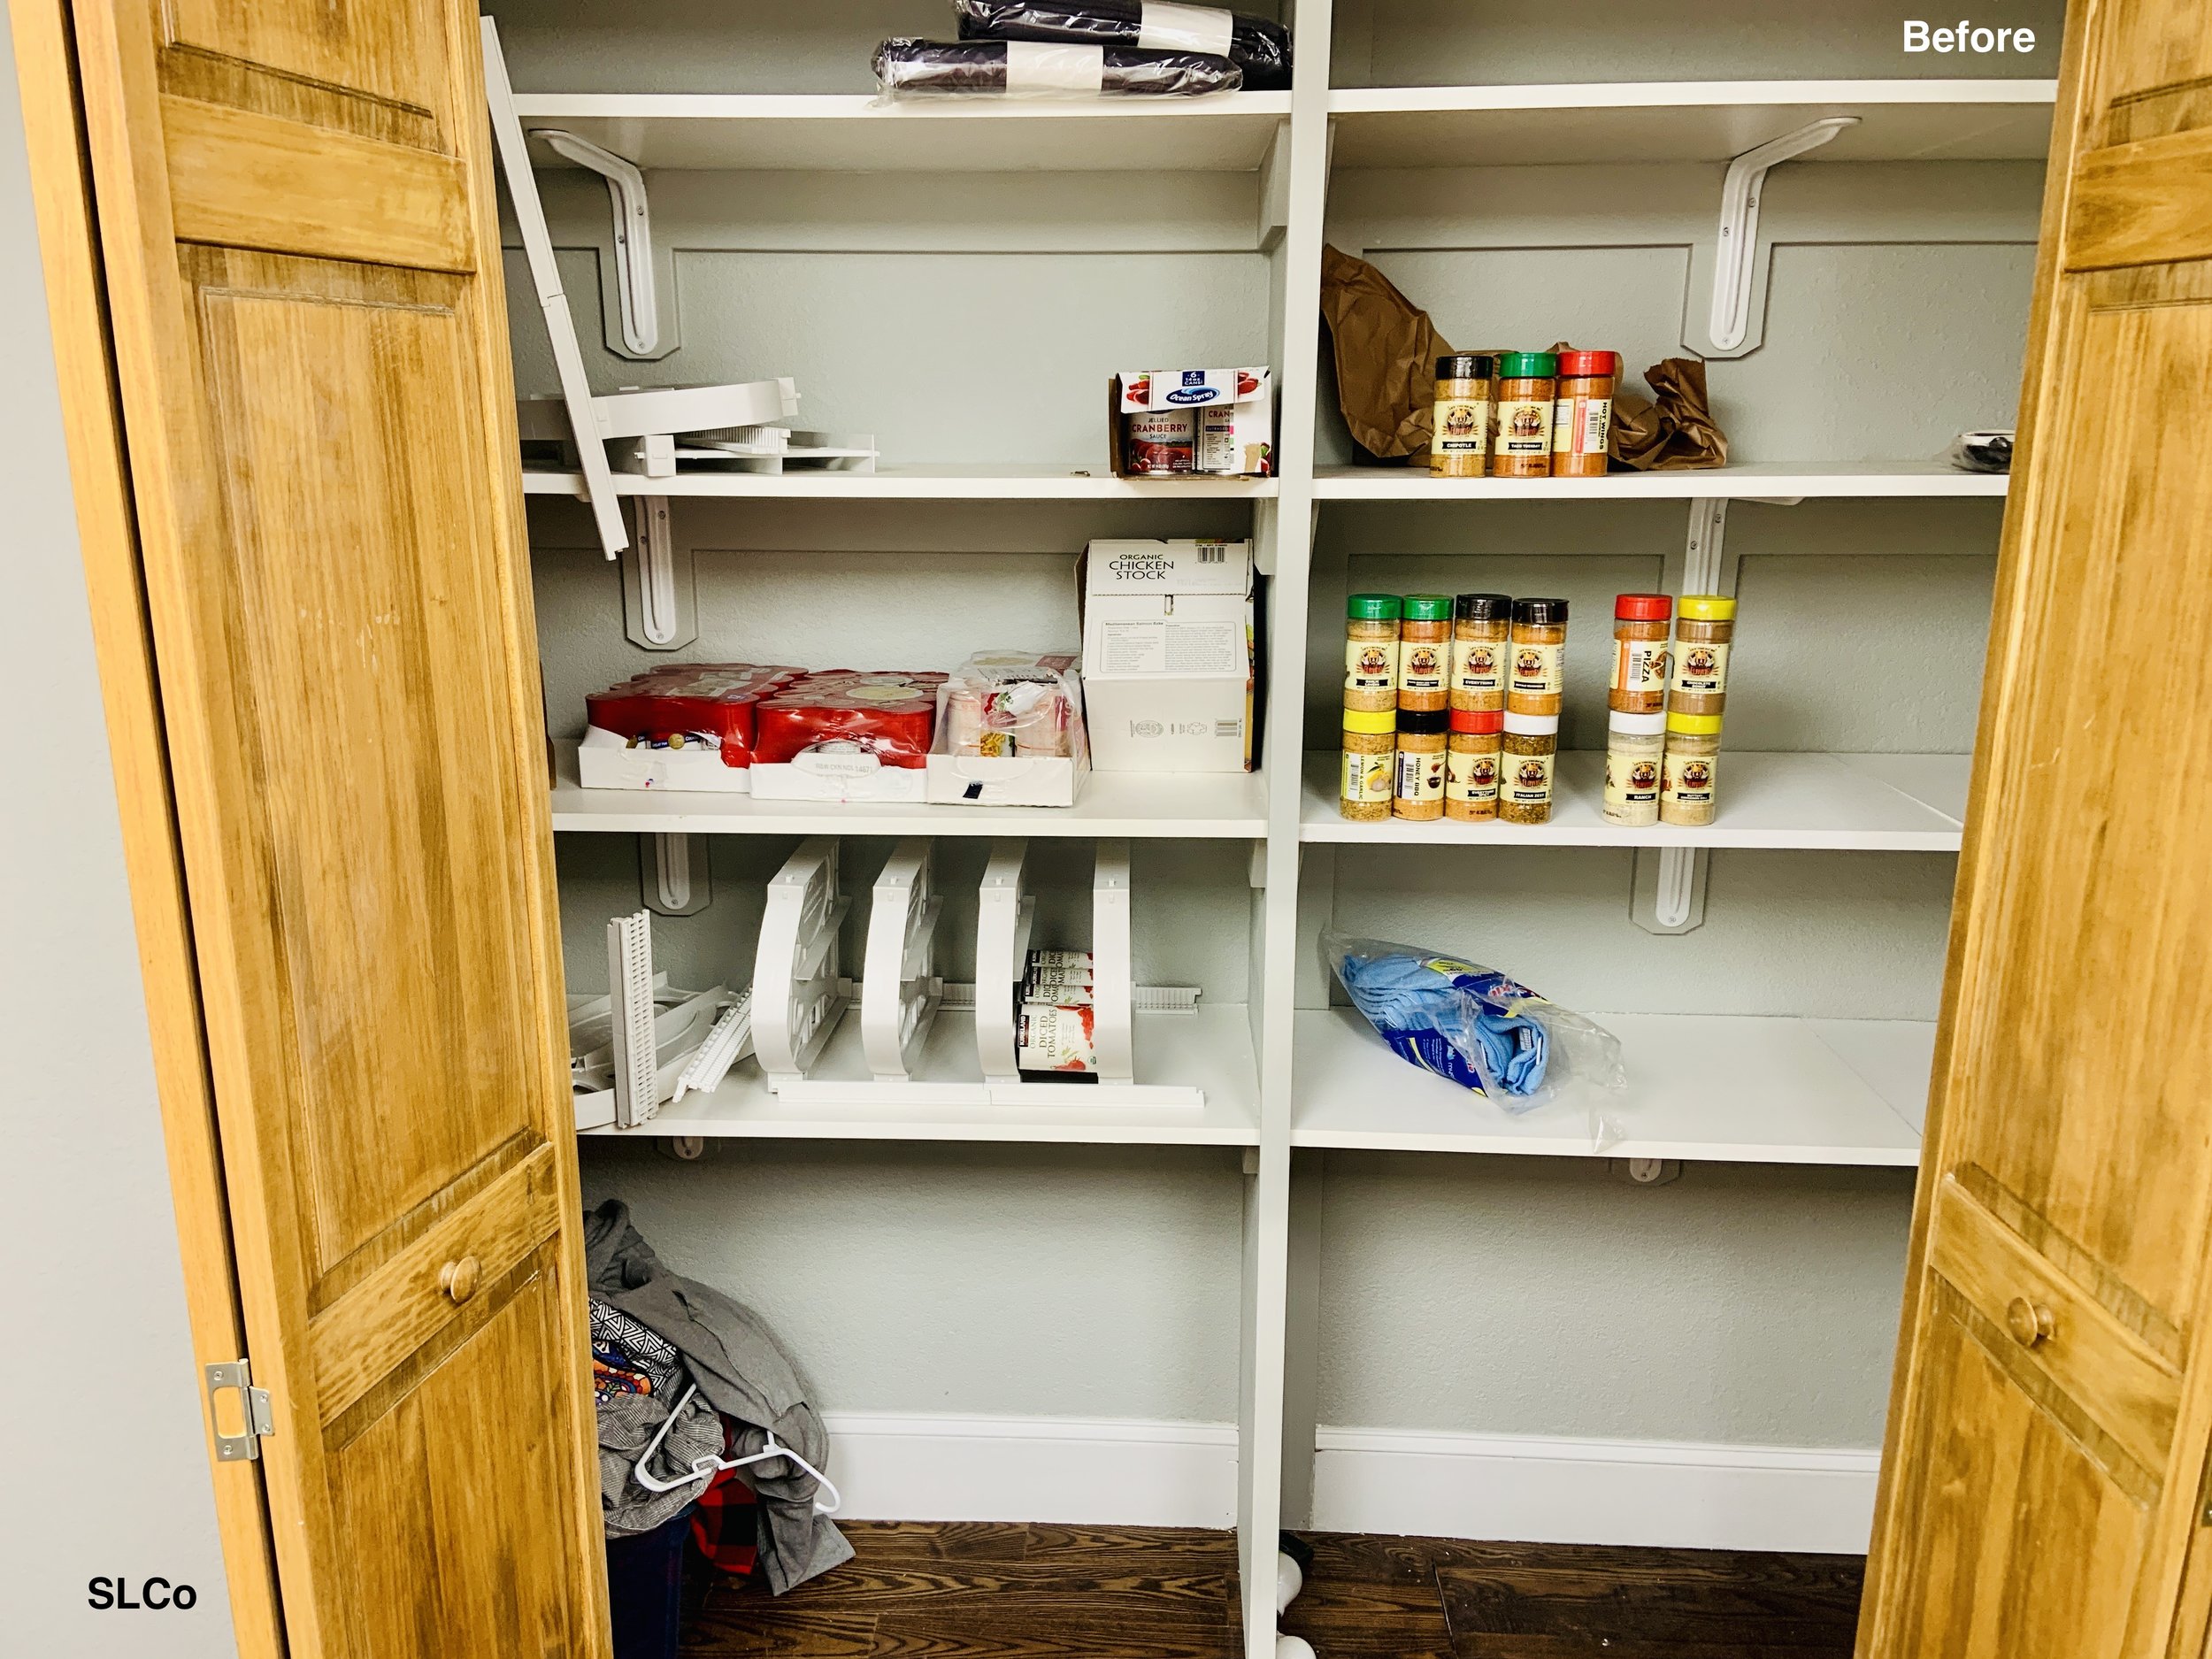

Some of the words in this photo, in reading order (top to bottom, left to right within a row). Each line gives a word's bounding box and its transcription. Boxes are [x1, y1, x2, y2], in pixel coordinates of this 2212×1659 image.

[1193, 391, 1213, 401] Spray
[1132, 424, 1187, 433] CRANBERRY
[1109, 560, 1175, 571] CHICKEN
[1116, 571, 1166, 580] STOCK
[1641, 650, 1652, 683] PIZZA
[1029, 1015, 1038, 1049] ORGANIC
[1039, 1016, 1048, 1048] DICED
[1048, 1009, 1057, 1059] TOMATOES
